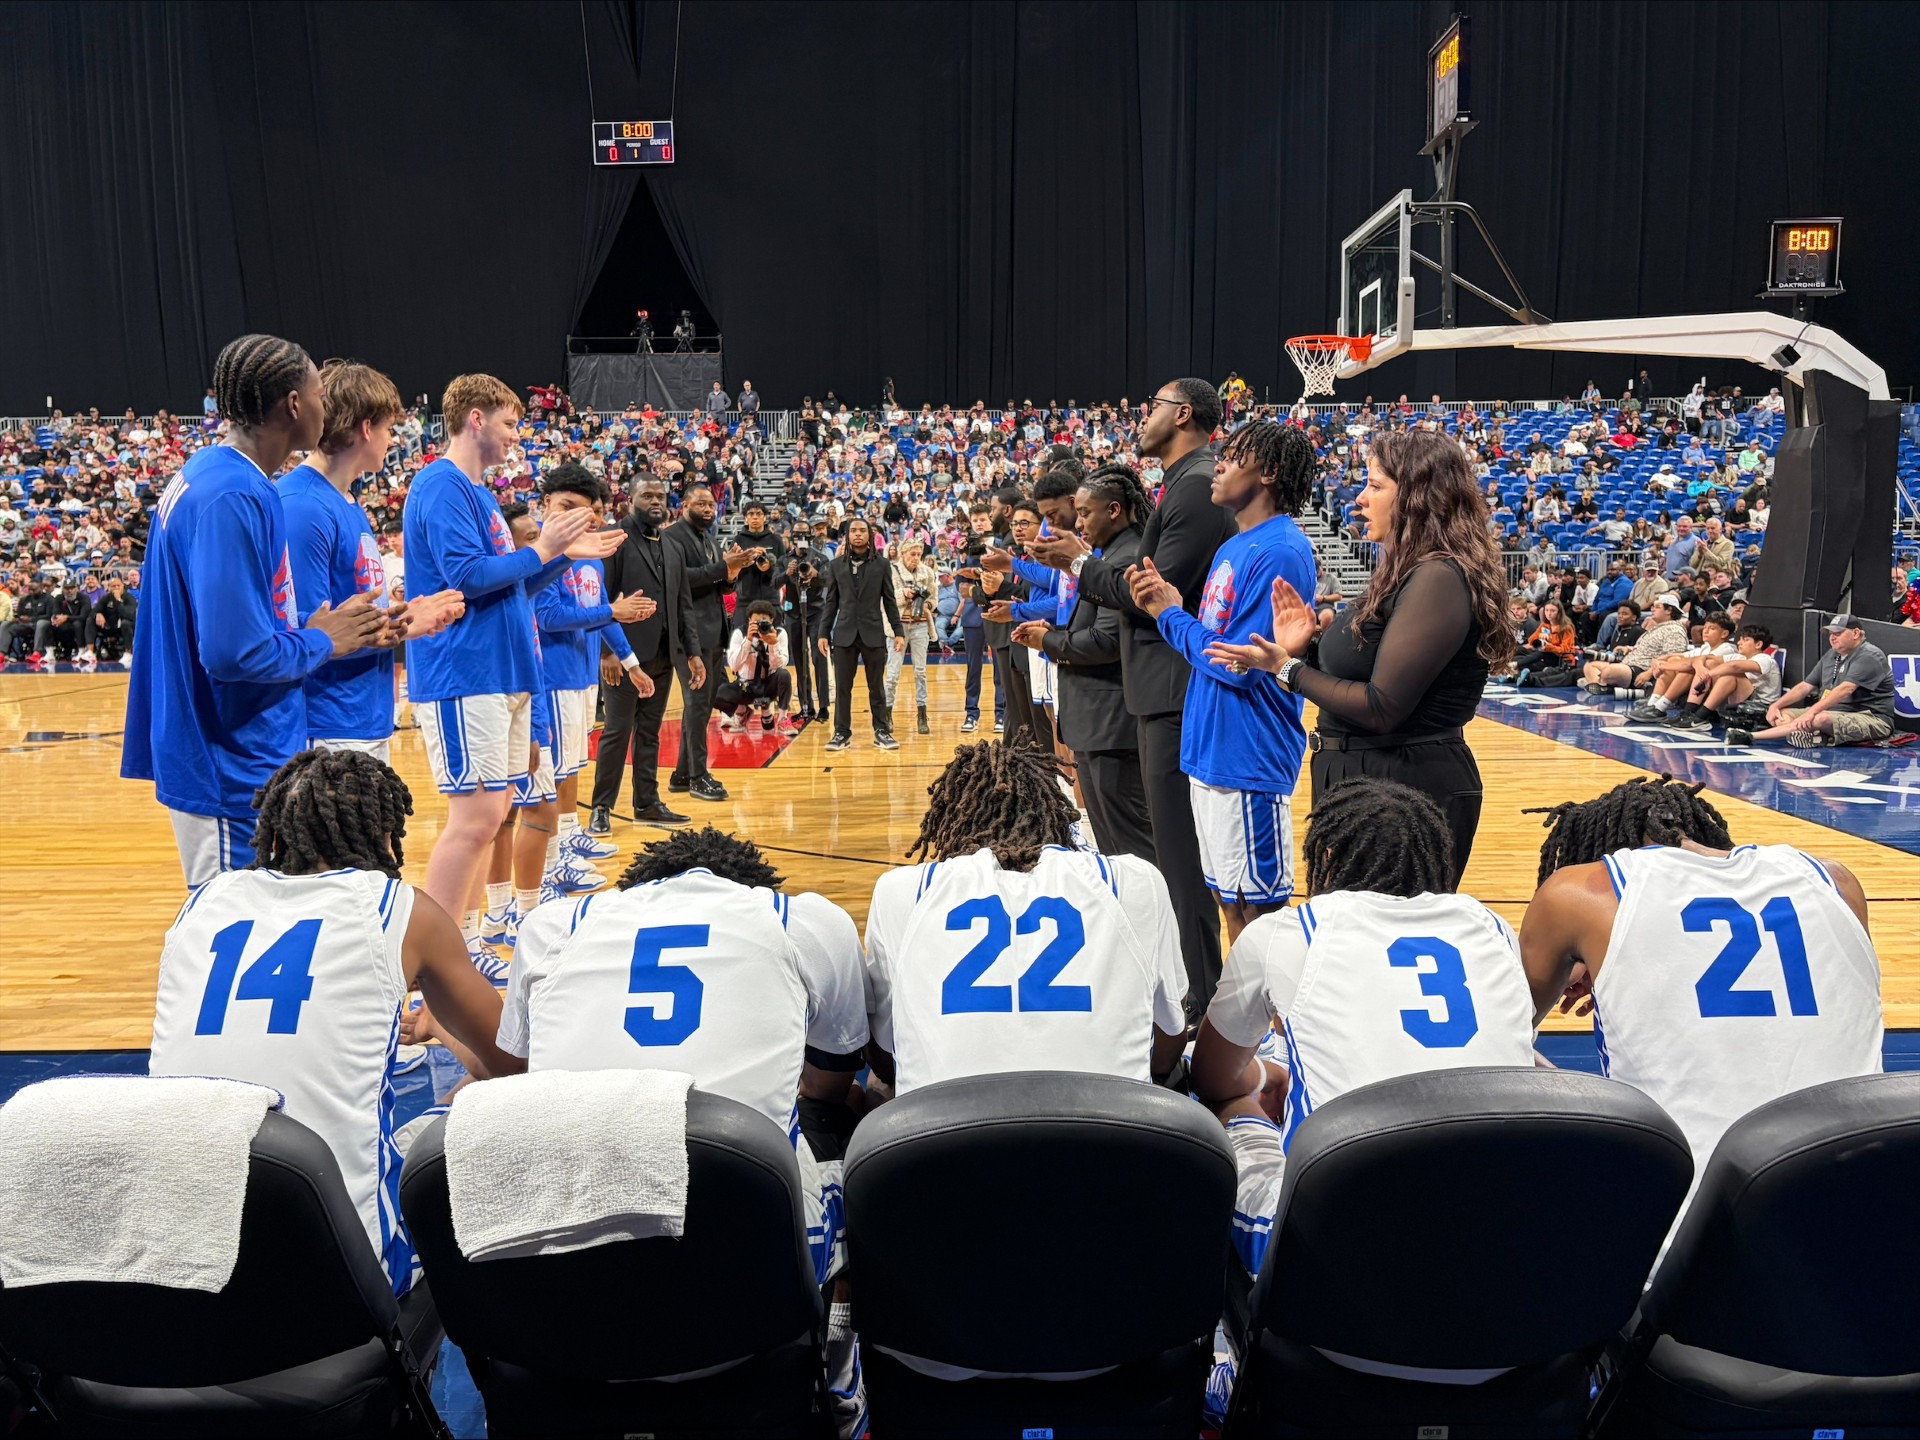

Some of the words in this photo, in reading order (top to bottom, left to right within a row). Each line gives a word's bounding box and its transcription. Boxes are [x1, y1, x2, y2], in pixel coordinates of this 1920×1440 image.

[598, 139, 616, 147] HOME
[649, 138, 669, 146] GUEST
[609, 147, 618, 161] 0
[633, 148, 638, 158] 1
[662, 145, 671, 159] 0
[623, 123, 651, 137] 8:00
[1788, 230, 1830, 251] 8:00
[195, 918, 324, 1036] 14
[624, 924, 711, 1047] 5
[942, 895, 1092, 1015] 22
[1387, 936, 1479, 1049] 3
[1680, 896, 1819, 1018] 21
